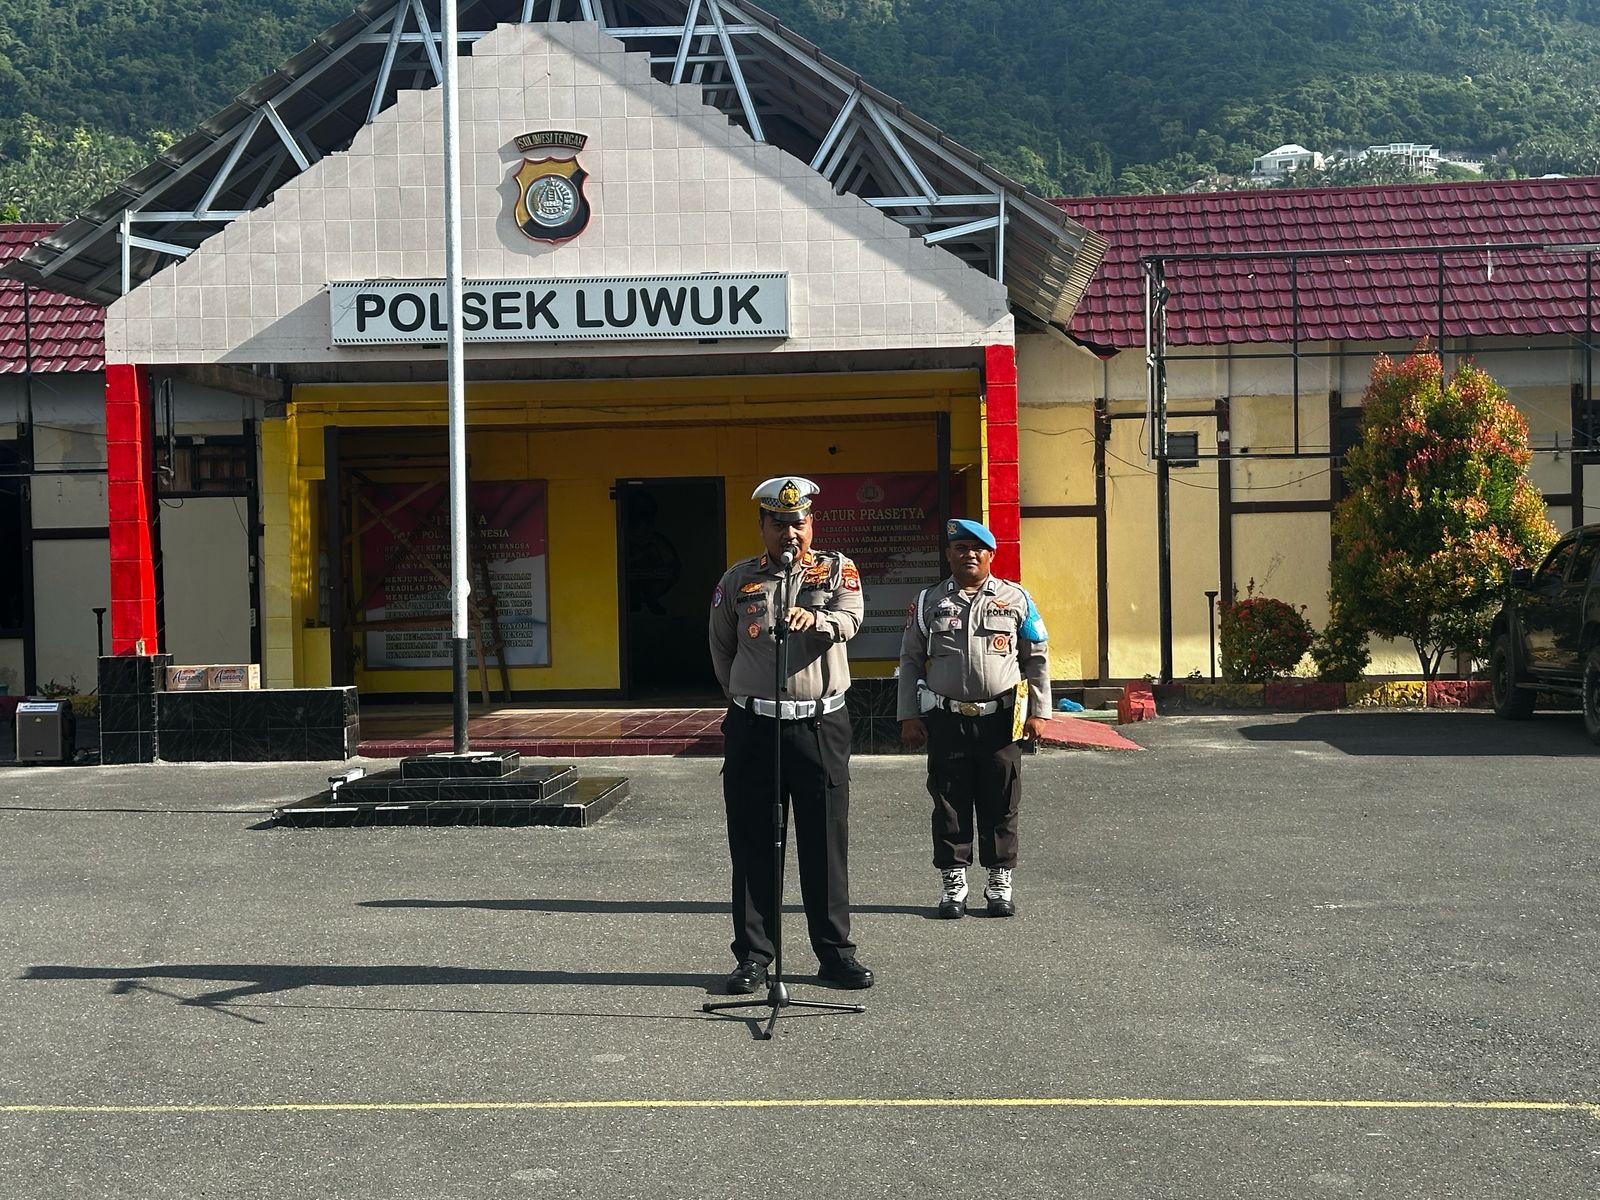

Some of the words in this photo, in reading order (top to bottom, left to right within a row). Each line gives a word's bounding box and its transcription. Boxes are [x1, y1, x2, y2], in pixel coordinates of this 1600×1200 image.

[554, 132, 584, 146] TENGAH
[356, 289, 560, 333] POLSEK
[576, 285, 763, 329] LUWUK
[814, 510, 856, 521] CATUR
[860, 507, 925, 520] PRASETYA
[986, 608, 1013, 617] POLRI
